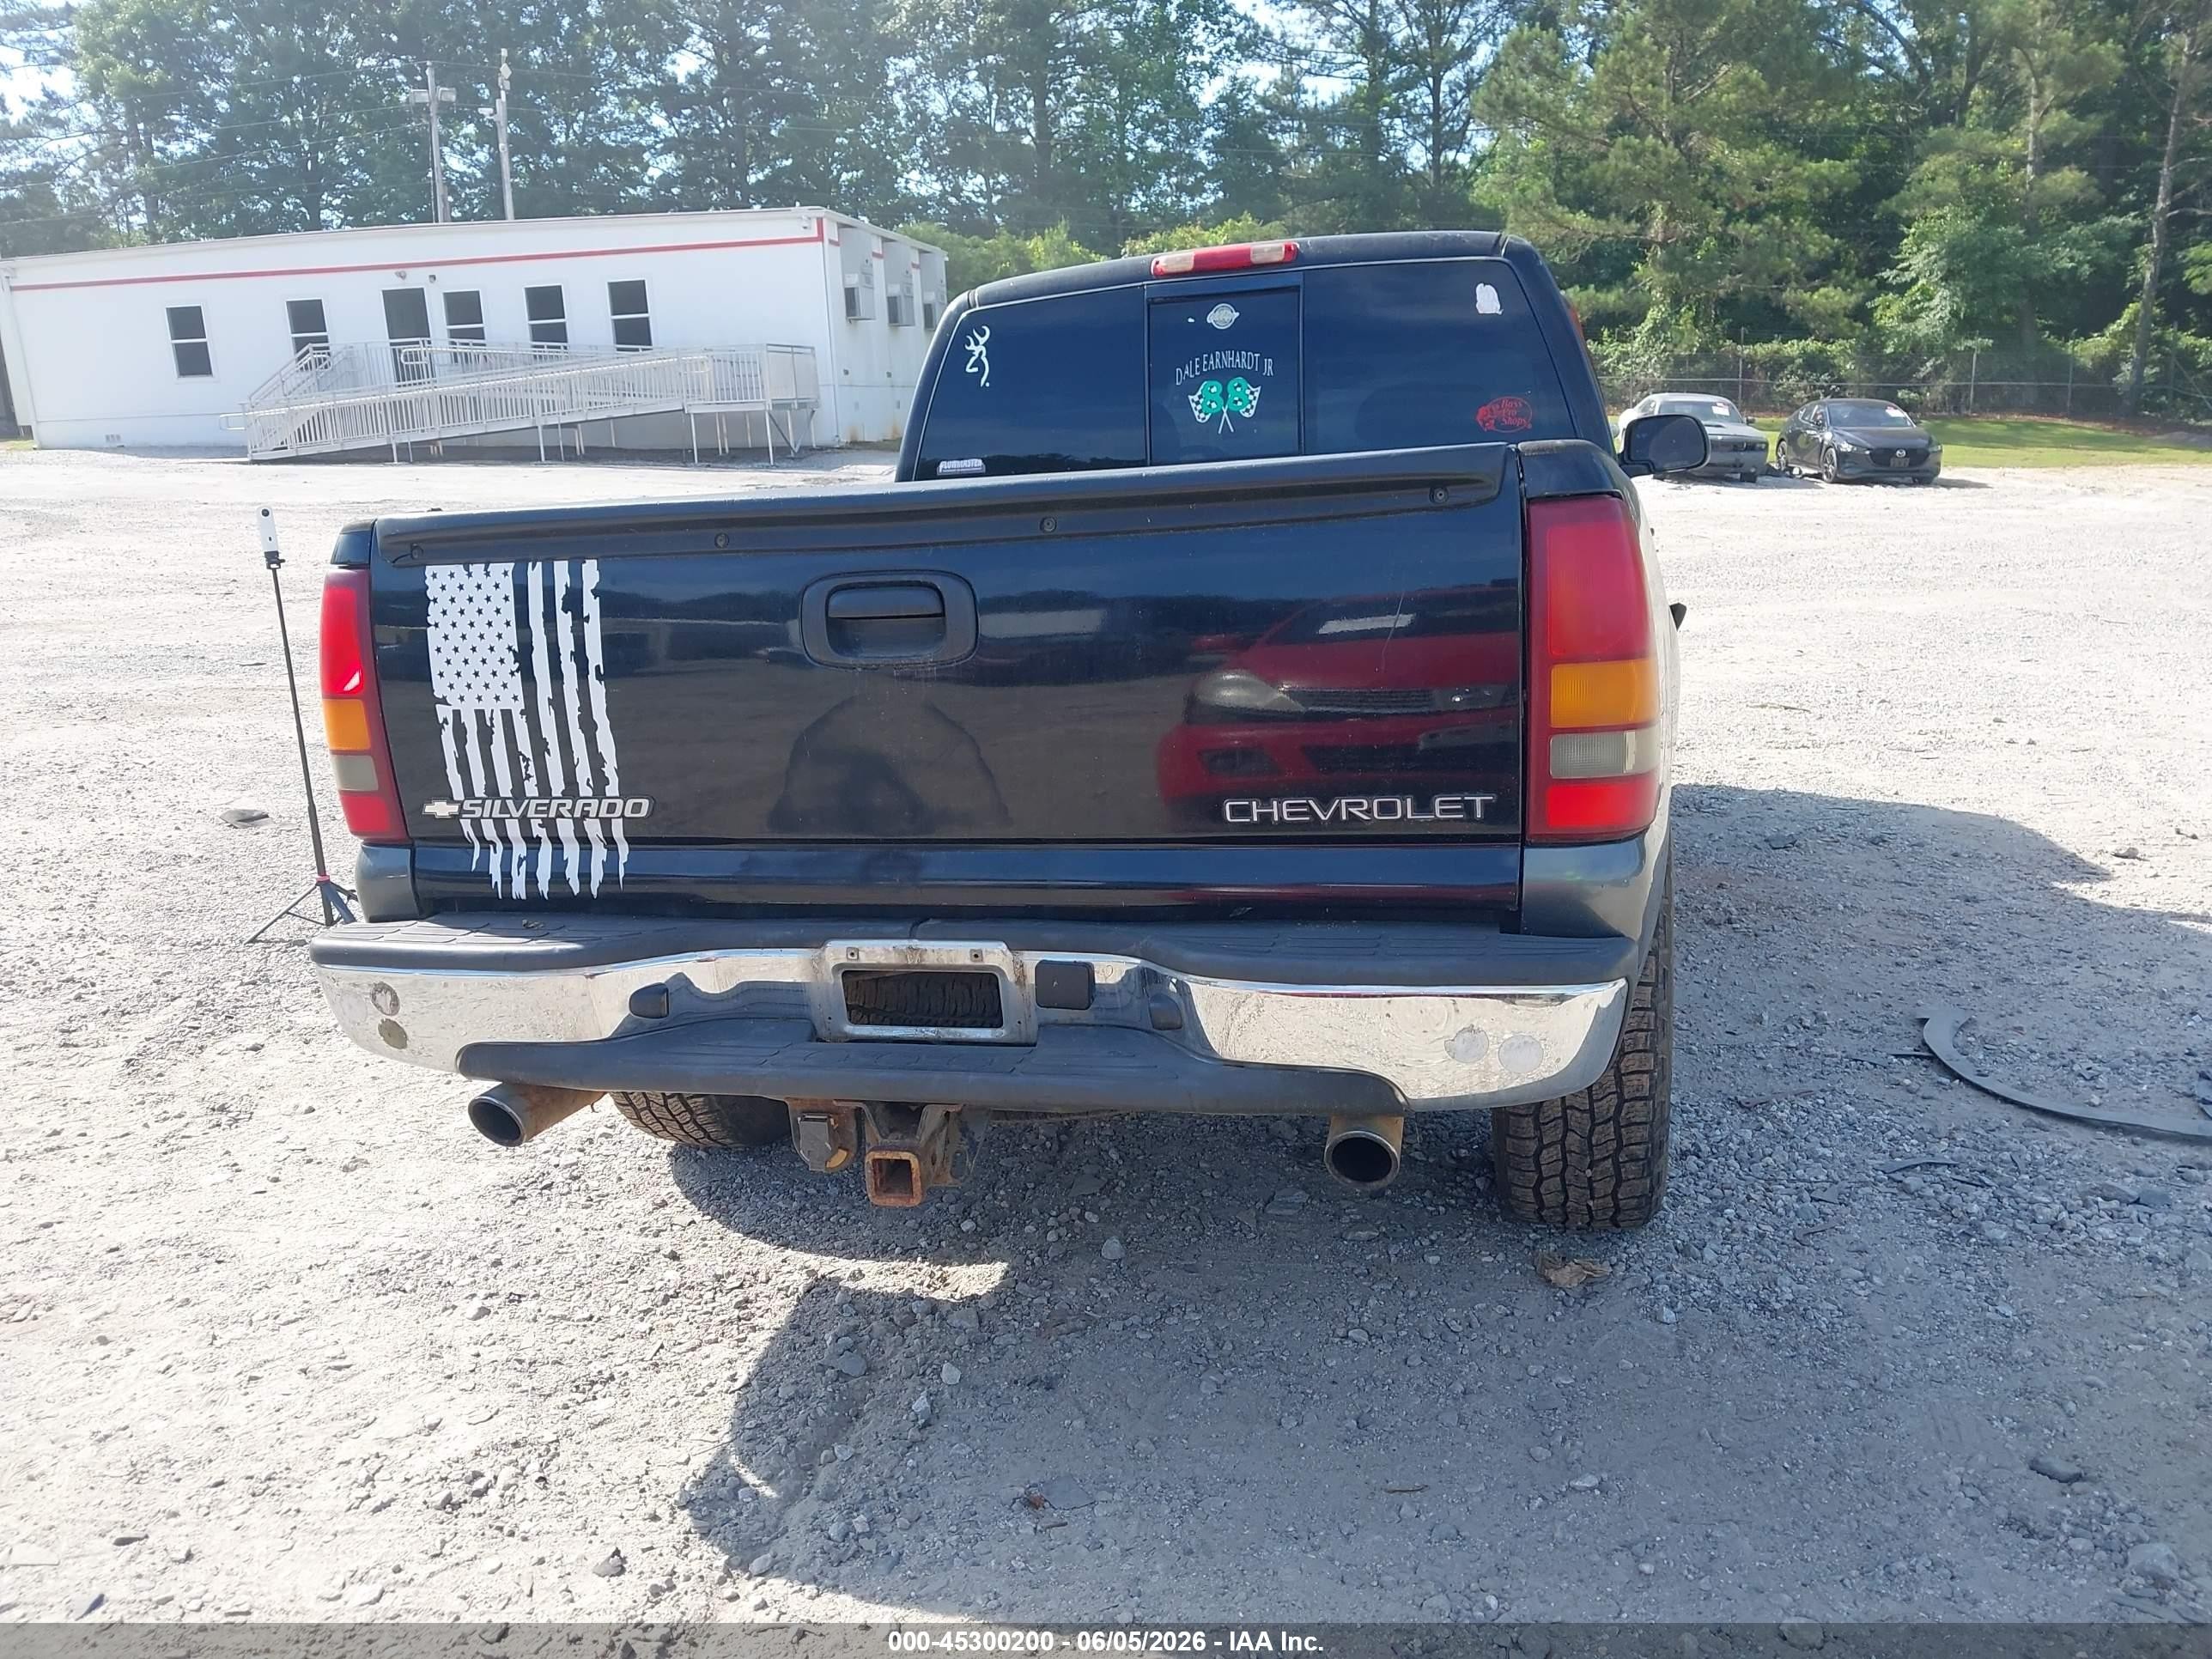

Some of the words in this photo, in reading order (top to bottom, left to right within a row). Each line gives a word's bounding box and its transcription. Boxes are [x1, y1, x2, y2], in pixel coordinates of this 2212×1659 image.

[1176, 357, 1200, 386] DALE
[1202, 349, 1261, 372] EARNHARDT
[1262, 358, 1273, 376] JR
[1201, 376, 1250, 414] 88
[1501, 398, 1523, 408] Bass
[940, 459, 983, 472] FLOWMASTER
[460, 798, 651, 819] SILVERADO
[1224, 795, 1494, 823] CHEVROLET
